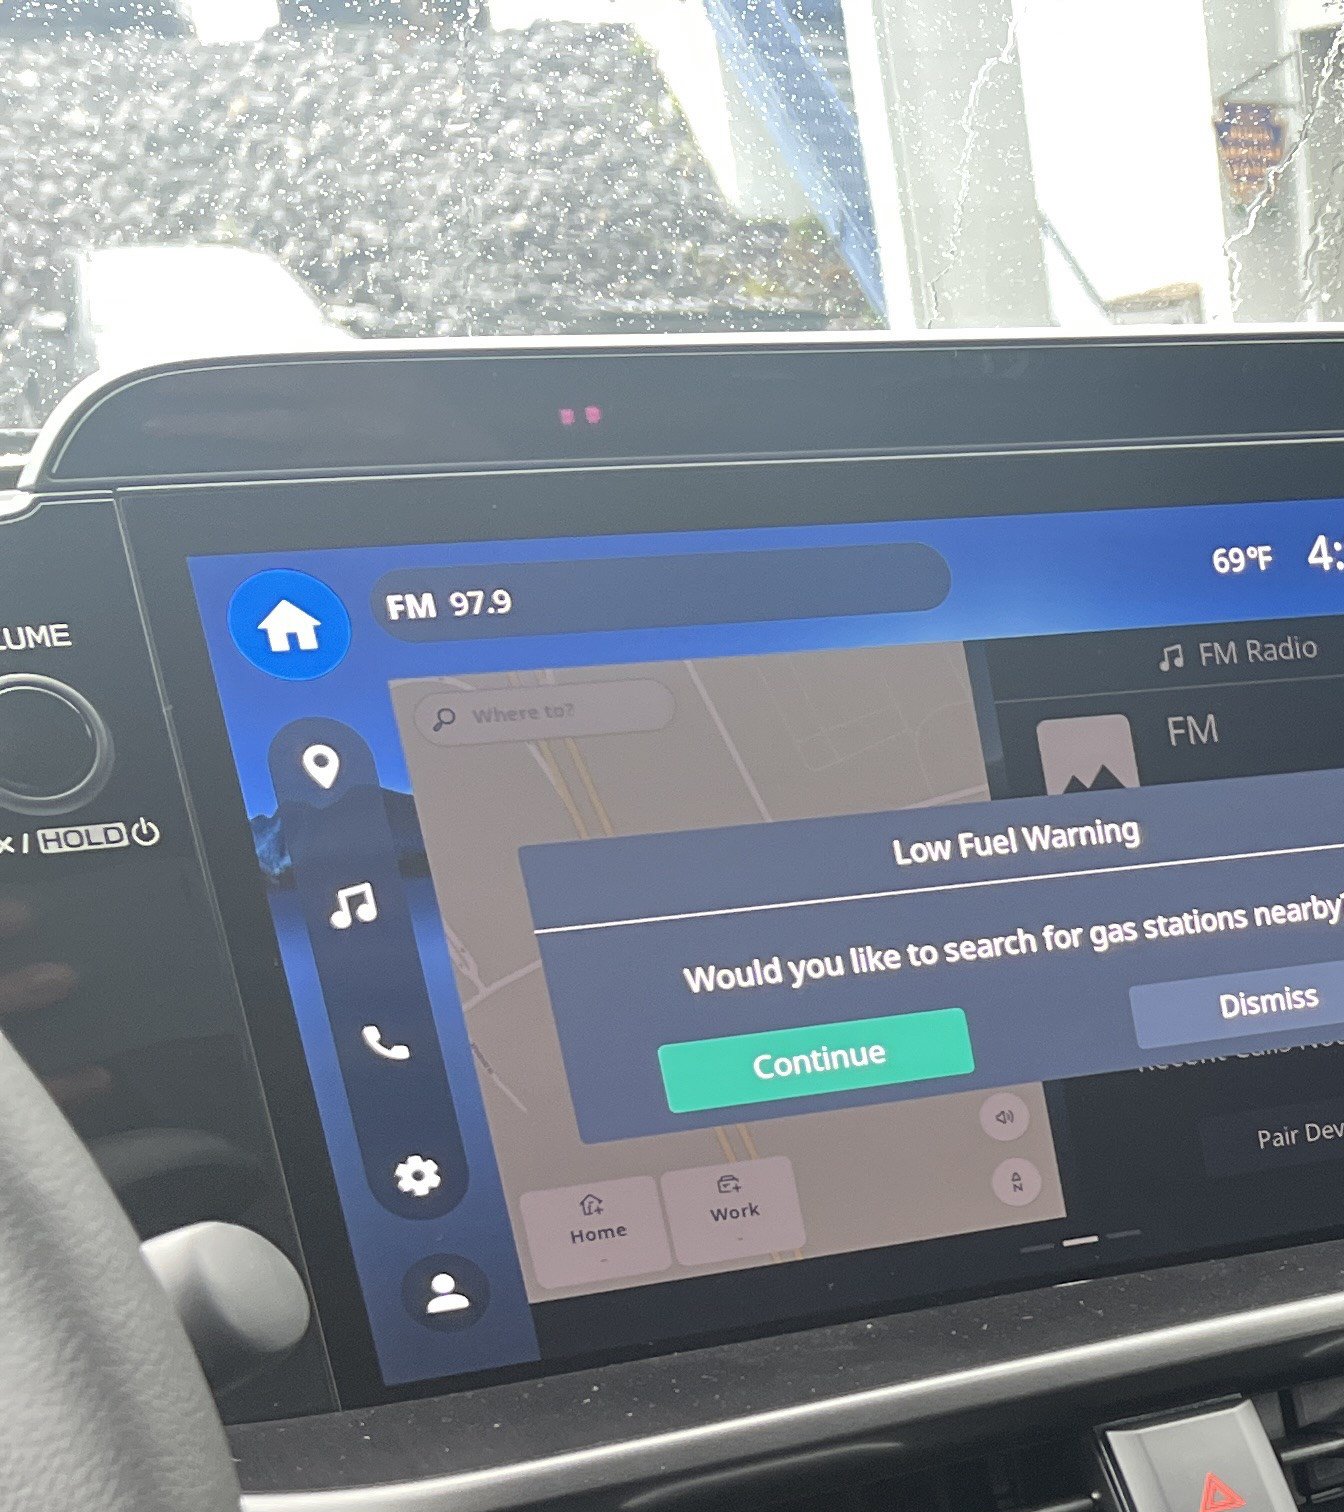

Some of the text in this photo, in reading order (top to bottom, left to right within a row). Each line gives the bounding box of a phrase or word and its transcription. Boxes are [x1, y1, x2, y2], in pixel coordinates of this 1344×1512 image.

[1212, 544, 1273, 574] 69°F
[386, 588, 513, 621] FM 97.9
[1200, 635, 1318, 668] FM Radio
[472, 700, 576, 726] Where to?
[1167, 714, 1219, 747] FM
[41, 826, 126, 850] HOLD
[892, 817, 1142, 867] Low Fuel Warning
[682, 956, 783, 994] Would
[789, 953, 845, 989] you
[850, 944, 901, 975] like
[906, 941, 939, 968] to
[944, 927, 1039, 964] search
[1042, 922, 1082, 951] for
[1090, 922, 1138, 952] gas
[1143, 905, 1249, 941] stations
[1219, 984, 1319, 1019] Dismiss
[752, 1040, 887, 1080] Continue
[1257, 1124, 1299, 1150] Pair
[710, 1201, 761, 1223] Work
[569, 1222, 629, 1245] Home
